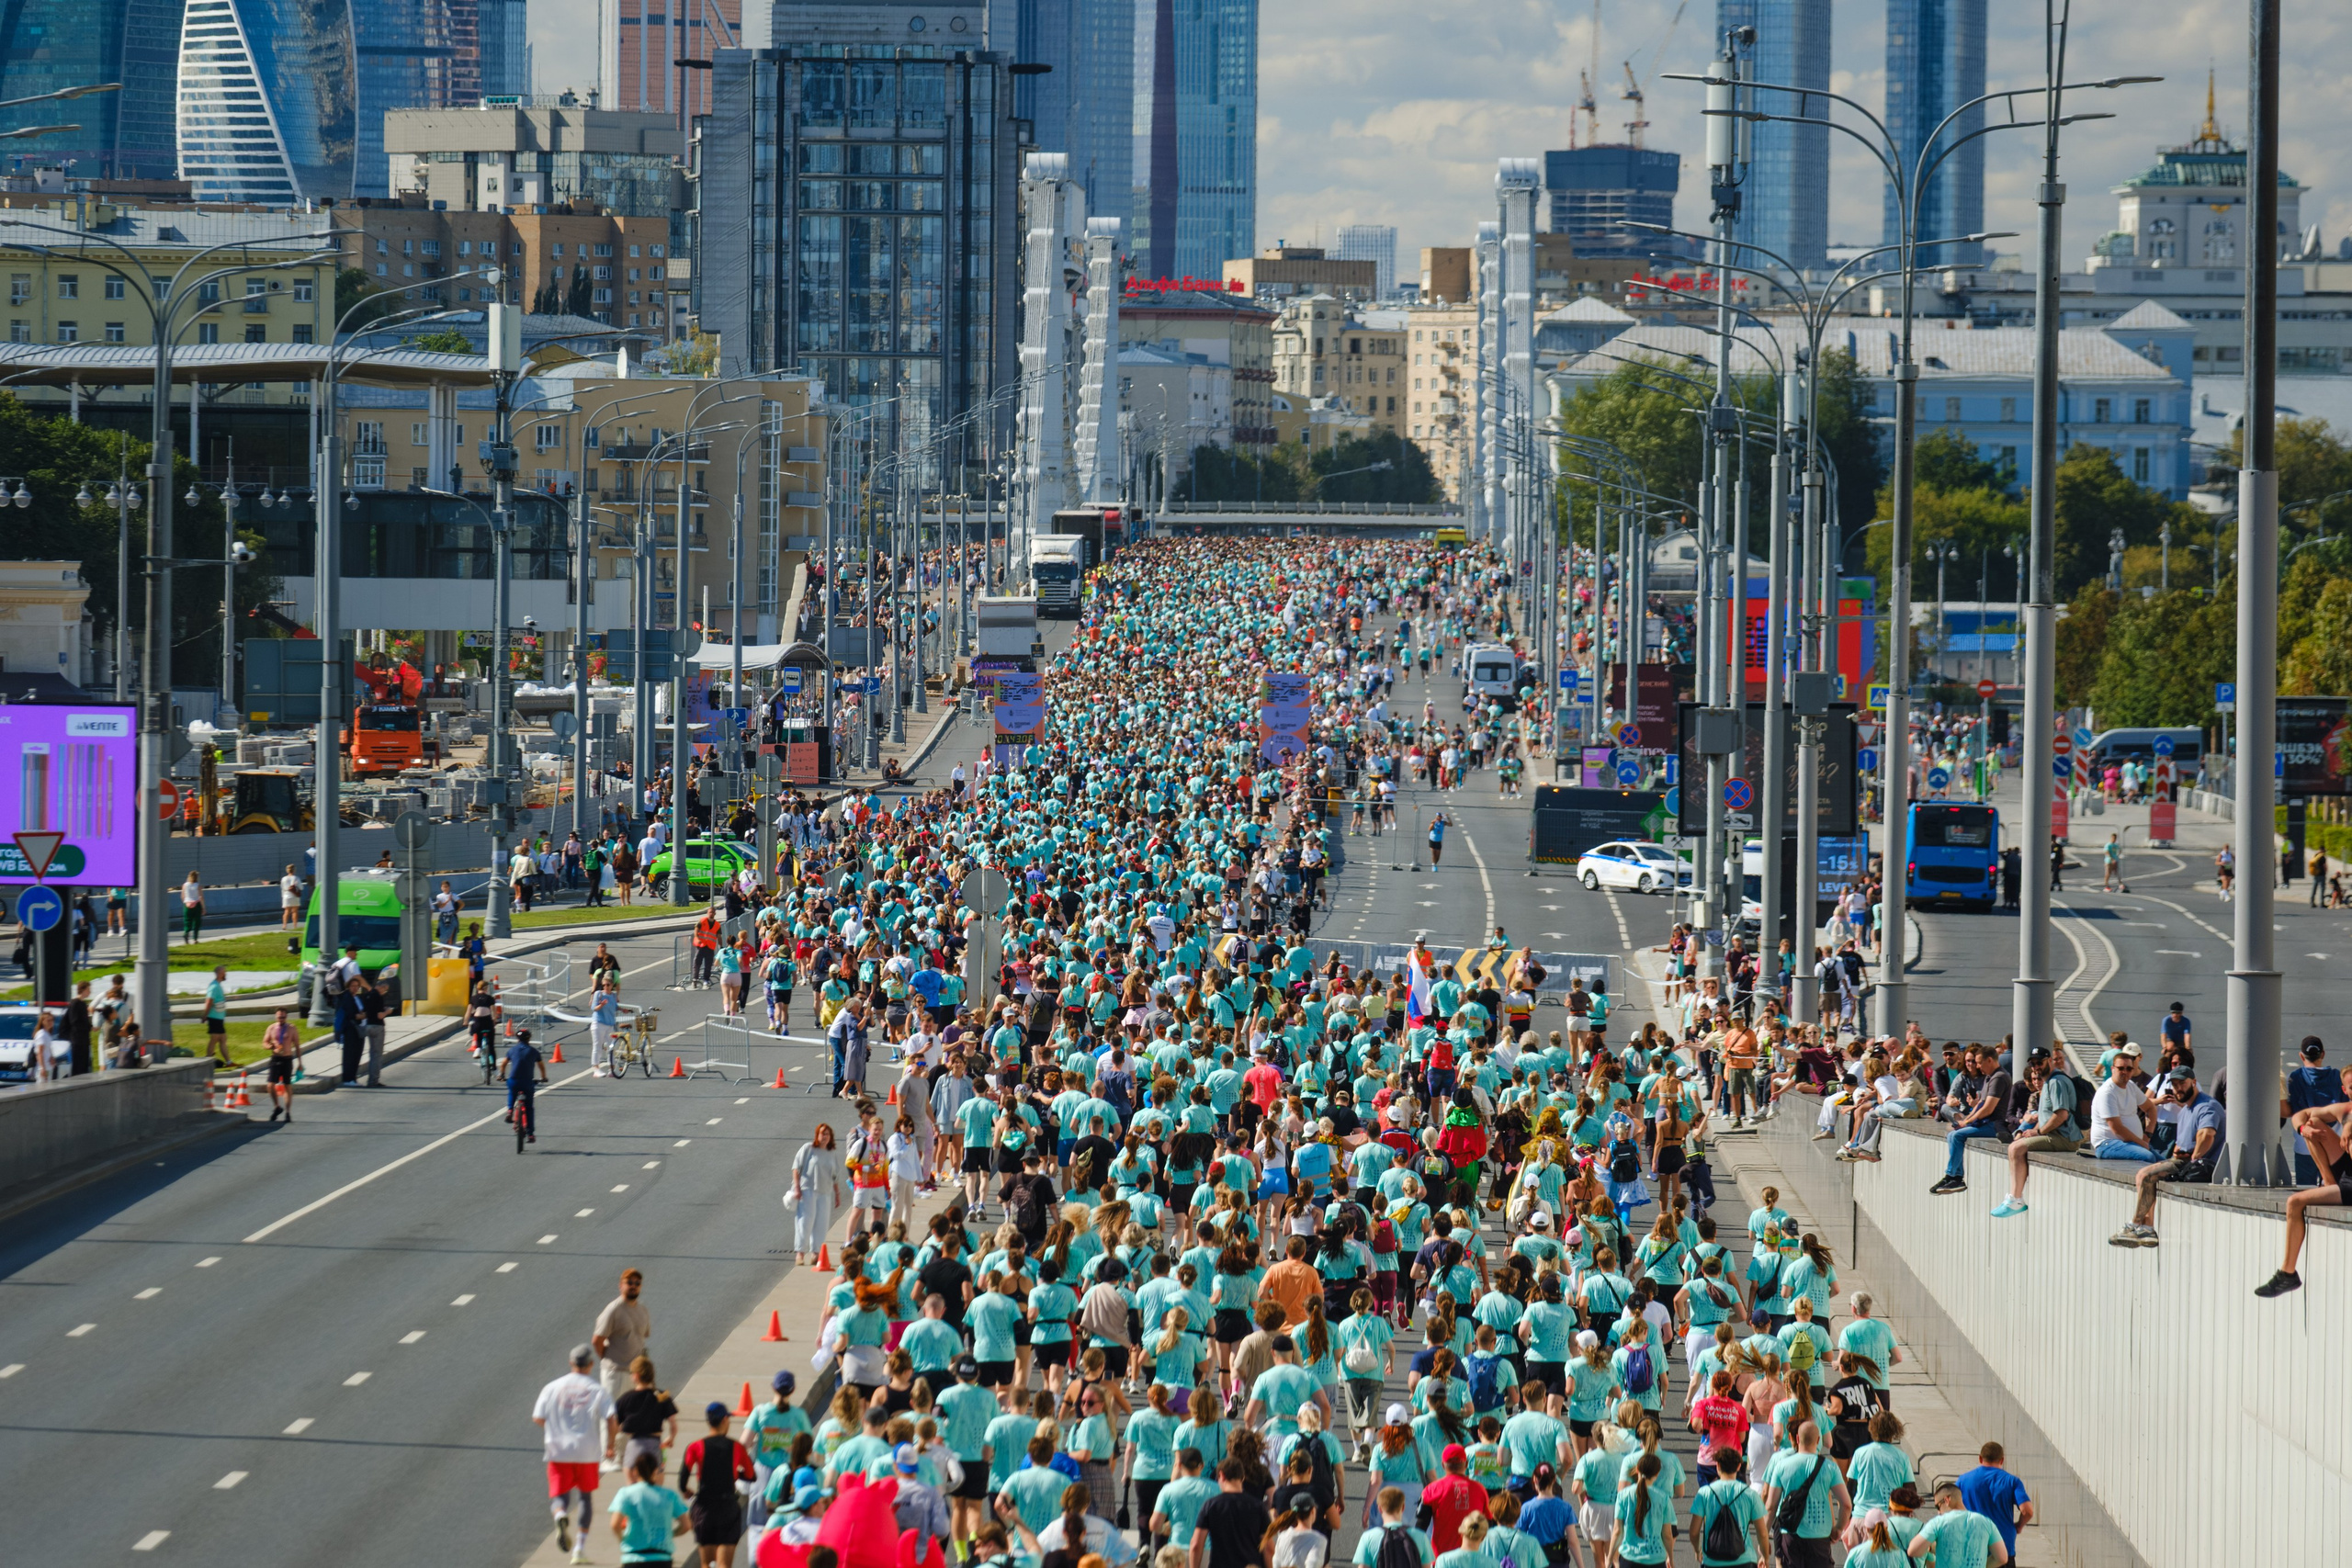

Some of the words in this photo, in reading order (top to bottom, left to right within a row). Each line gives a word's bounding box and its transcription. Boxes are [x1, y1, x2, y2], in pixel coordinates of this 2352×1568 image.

[1125, 276, 1179, 295] Альфа
[1182, 276, 1224, 291] Банк
[1700, 273, 1749, 291] Бак
[1640, 745, 1668, 756] inex
[2276, 742, 2324, 753] ЭШБЭК
